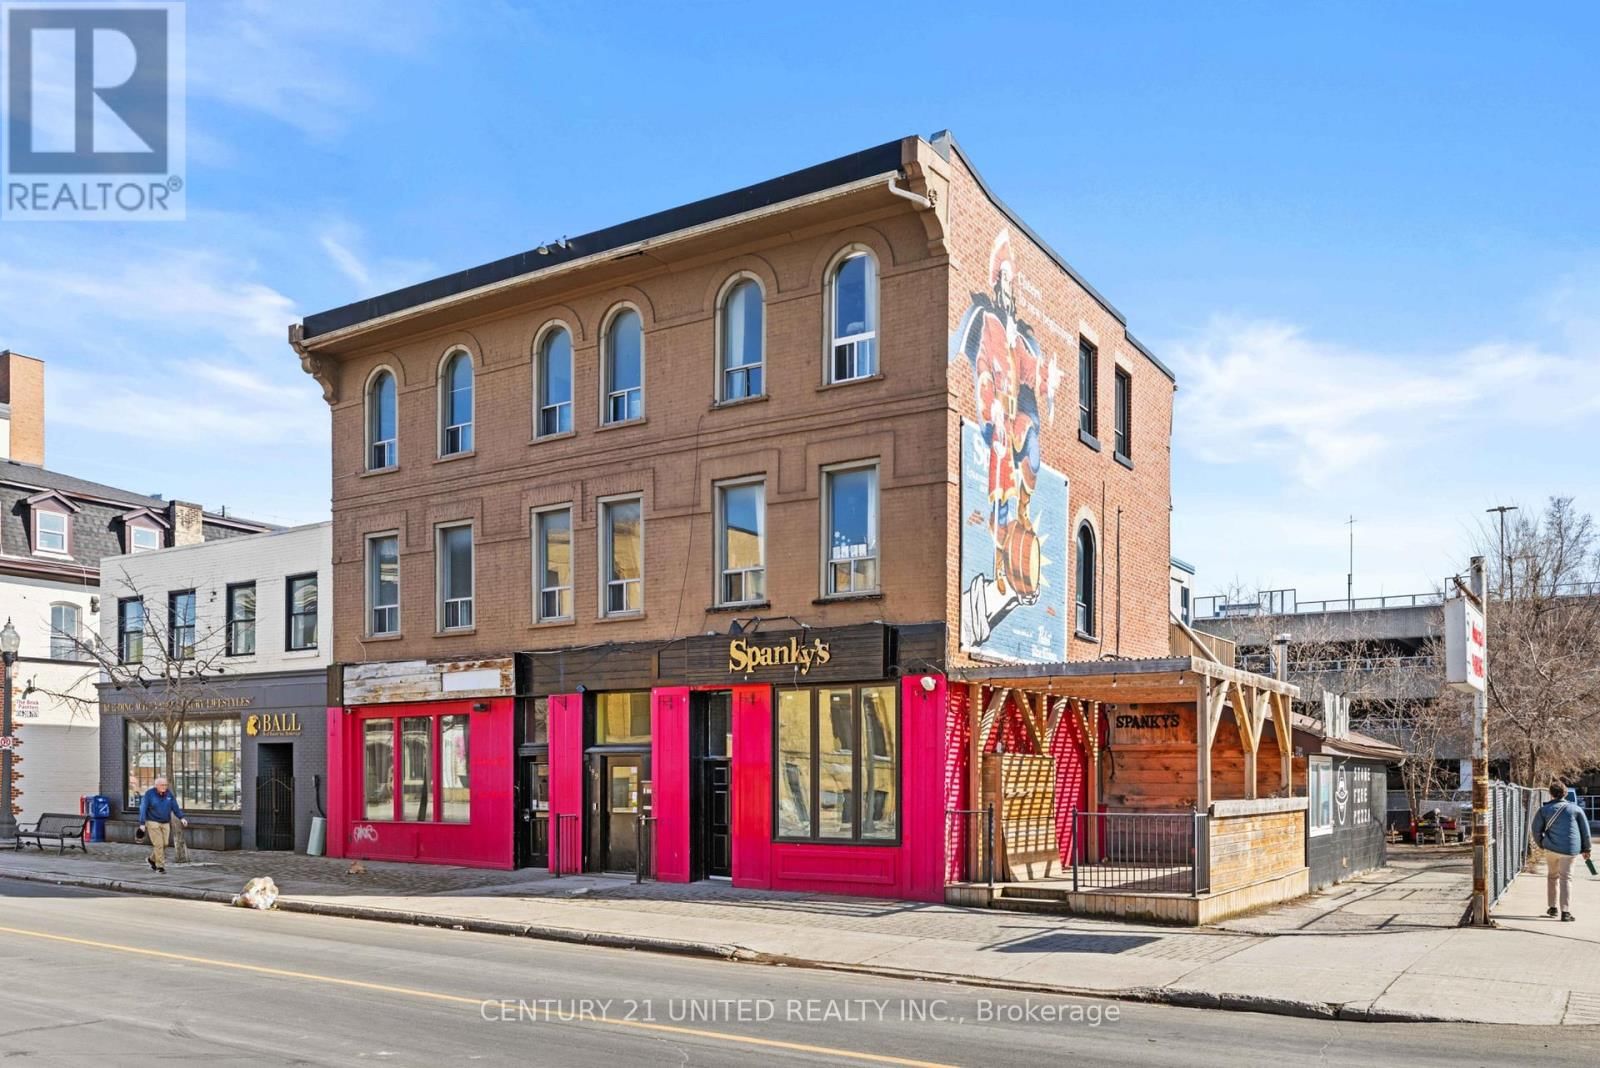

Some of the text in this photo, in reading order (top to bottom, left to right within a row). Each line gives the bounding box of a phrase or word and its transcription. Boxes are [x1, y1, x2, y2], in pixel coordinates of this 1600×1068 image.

[729, 636, 830, 675] Spanky's
[263, 713, 301, 731] BALL
[1116, 714, 1180, 729] SPANKYS
[1354, 766, 1370, 781] STONE
[1354, 787, 1367, 803] FIRE
[1354, 808, 1370, 824] PIZZA
